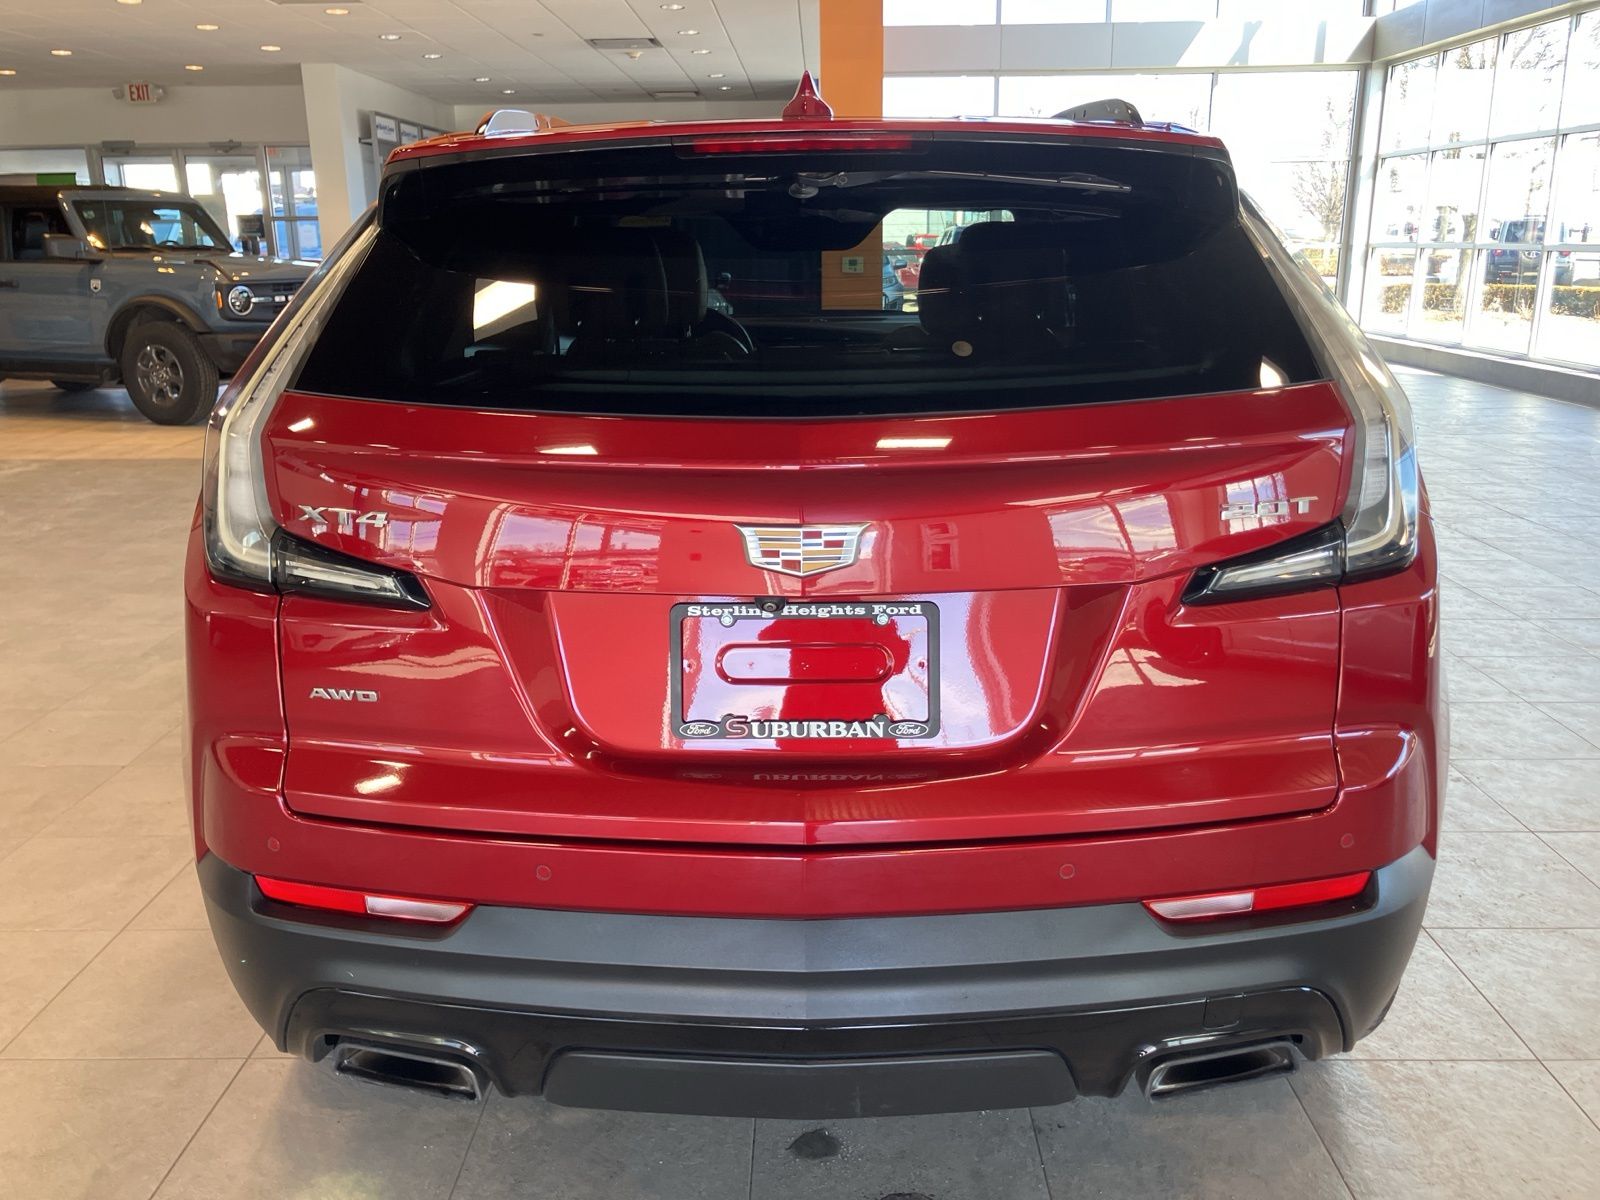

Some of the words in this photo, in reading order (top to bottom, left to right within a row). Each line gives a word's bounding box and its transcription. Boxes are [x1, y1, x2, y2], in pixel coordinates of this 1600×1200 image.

[128, 84, 150, 101] EXIT
[298, 505, 388, 528] XT4
[780, 604, 866, 618] Heights
[871, 604, 922, 615] Ford
[309, 687, 378, 702] AWD
[686, 724, 712, 735] Ford
[725, 718, 884, 738] SUBURBAN
[895, 724, 921, 735] Ford
